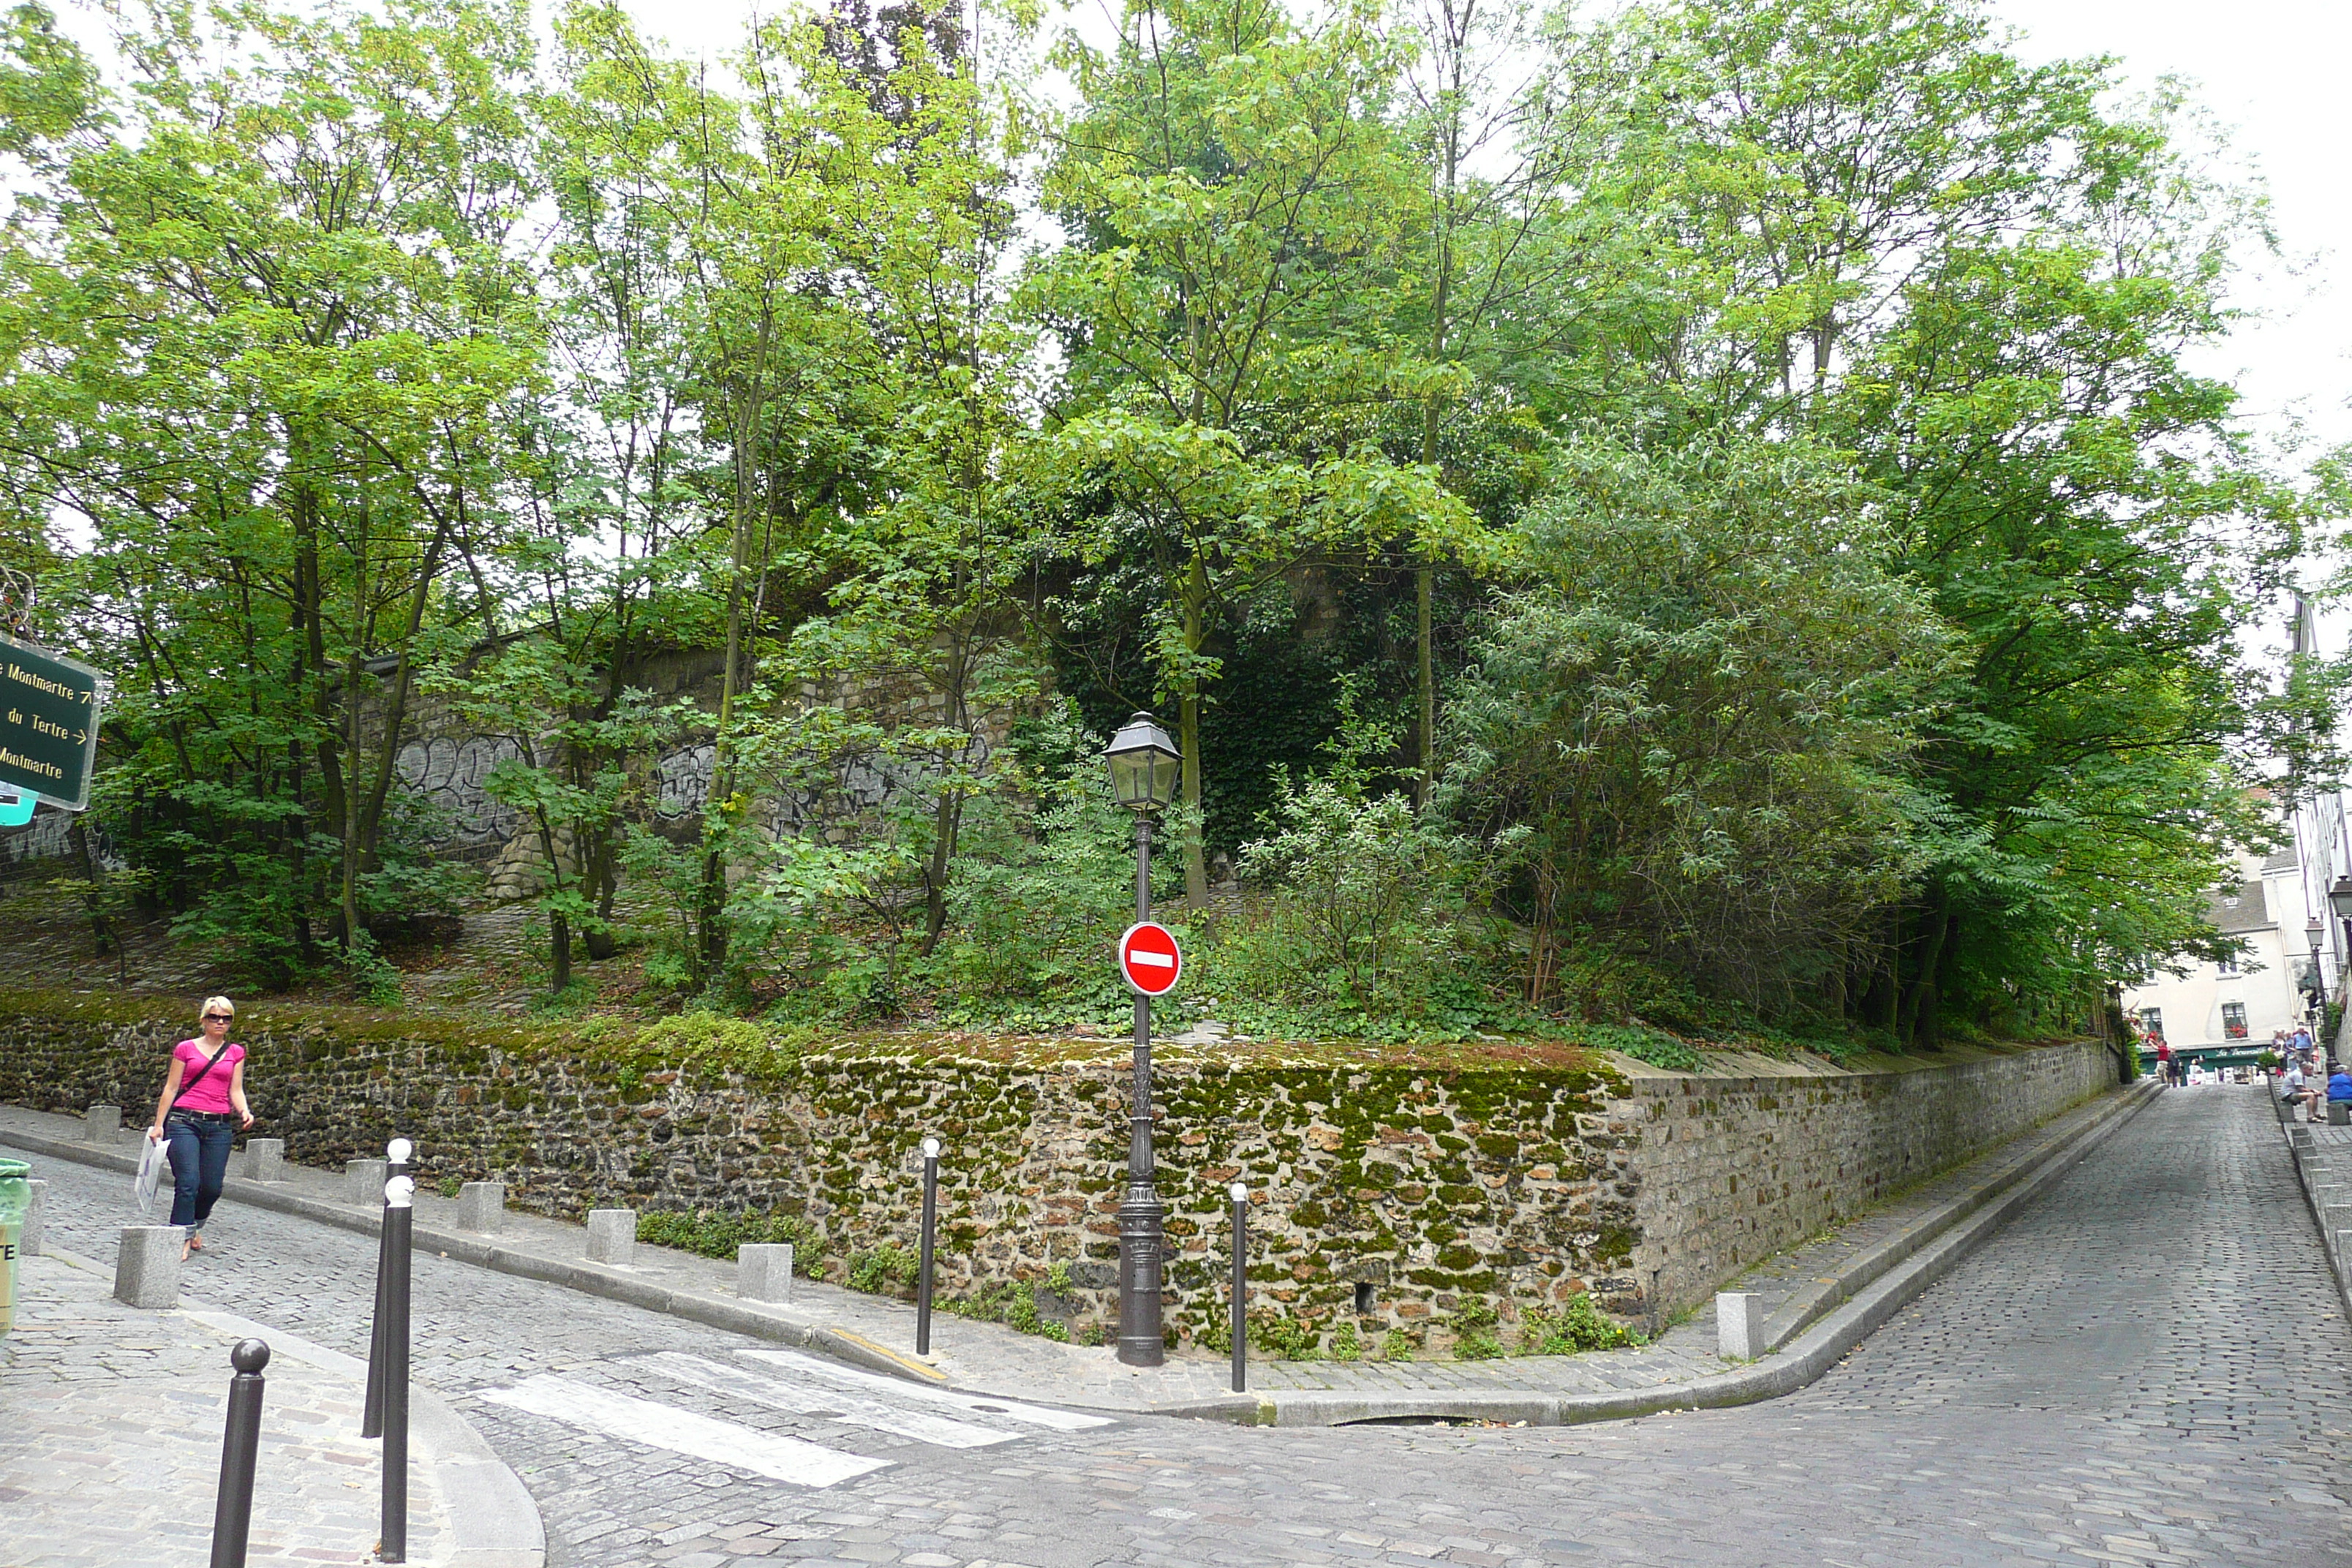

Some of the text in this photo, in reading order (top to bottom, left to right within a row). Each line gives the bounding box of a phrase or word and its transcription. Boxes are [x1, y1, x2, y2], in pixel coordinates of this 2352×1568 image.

[8, 663, 74, 700] Montmartre
[8, 707, 69, 740] du Tertre
